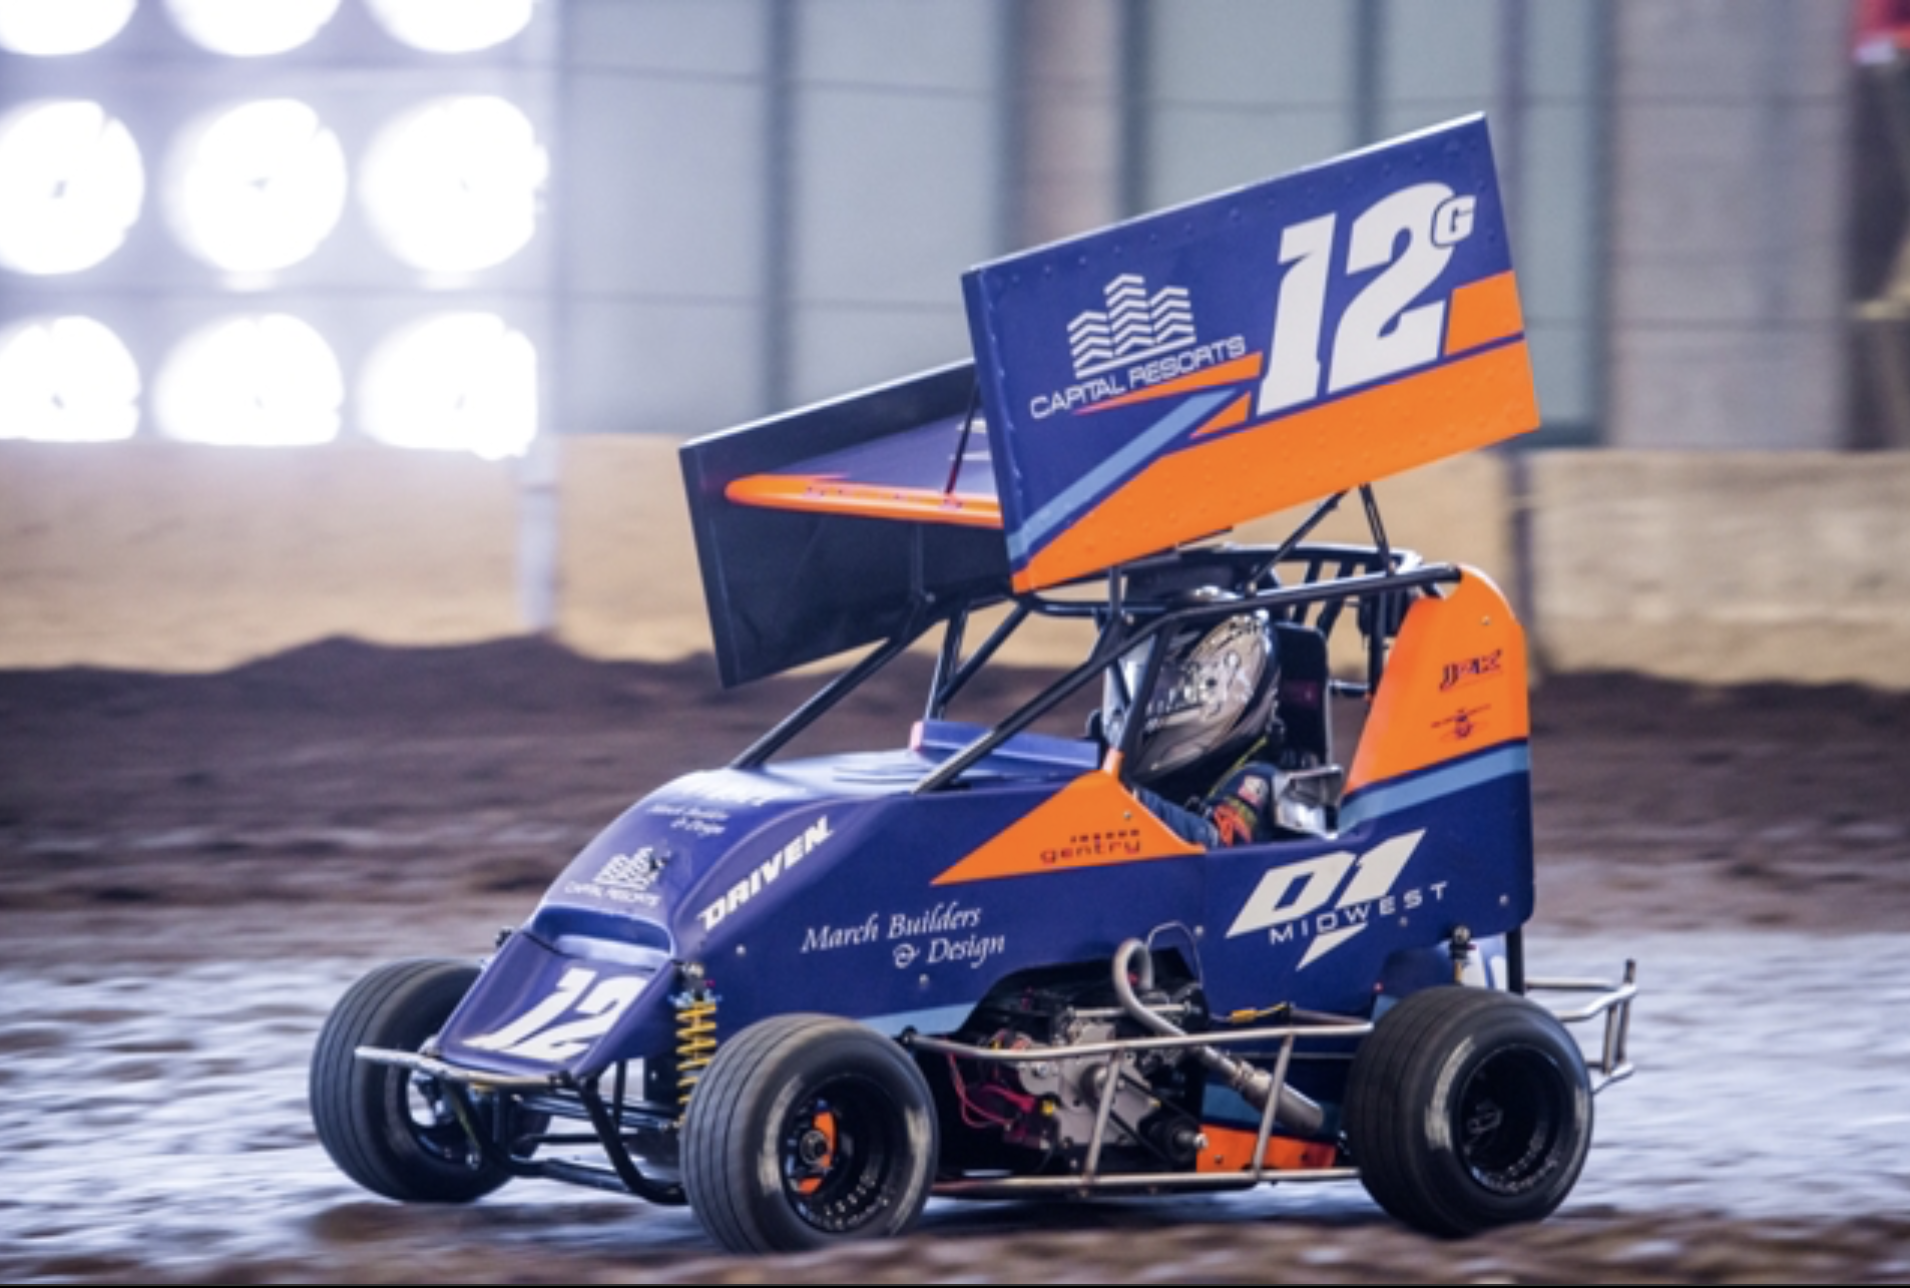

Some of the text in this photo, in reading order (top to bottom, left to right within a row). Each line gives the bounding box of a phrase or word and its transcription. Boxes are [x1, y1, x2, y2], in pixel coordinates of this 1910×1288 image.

[1030, 334, 1246, 419] CAPITAL RESORTS
[696, 815, 834, 931] DRIVEN
[1040, 840, 1141, 867] gentry
[800, 901, 982, 953] March Builders
[1269, 881, 1448, 945] MIDWEST
[926, 934, 1006, 969] Design
[461, 967, 649, 1061] 12
